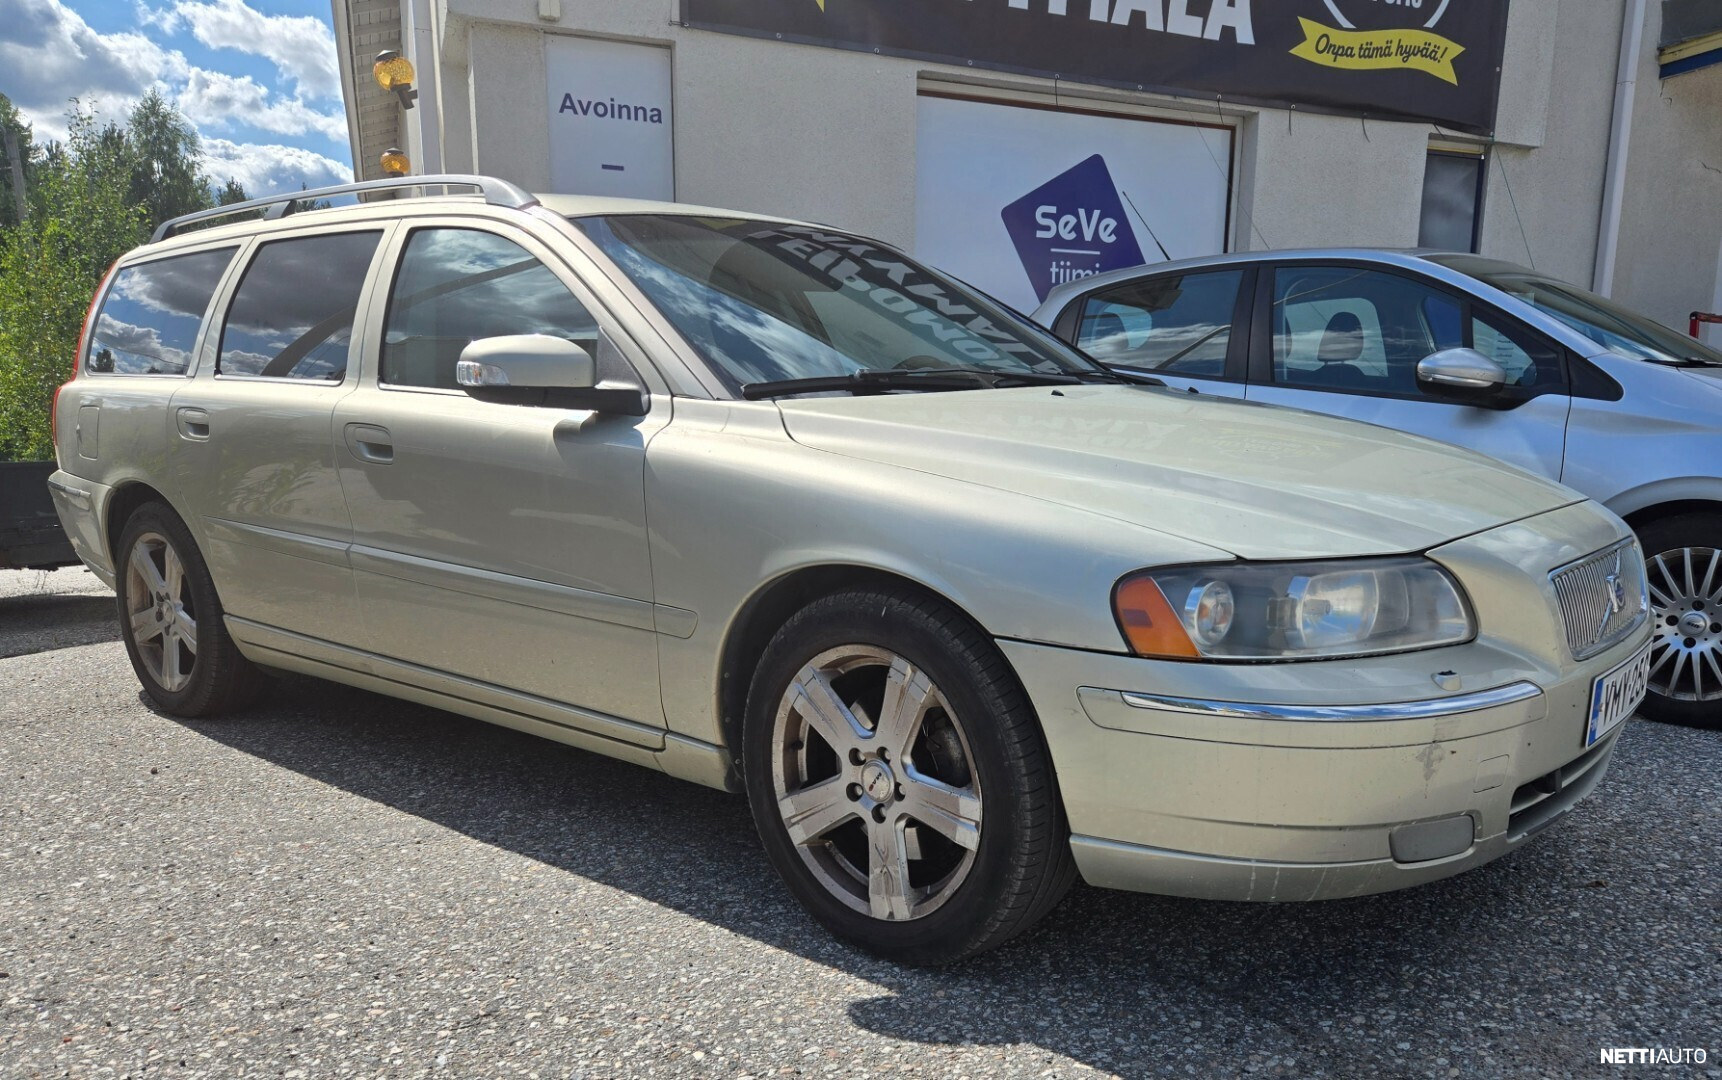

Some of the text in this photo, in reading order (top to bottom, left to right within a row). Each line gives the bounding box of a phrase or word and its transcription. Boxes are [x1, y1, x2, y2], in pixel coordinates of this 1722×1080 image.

[1314, 33, 1448, 63] Onpa tämä hyvää!
[559, 92, 662, 124] Avoinna
[1035, 205, 1118, 243] SeVe
